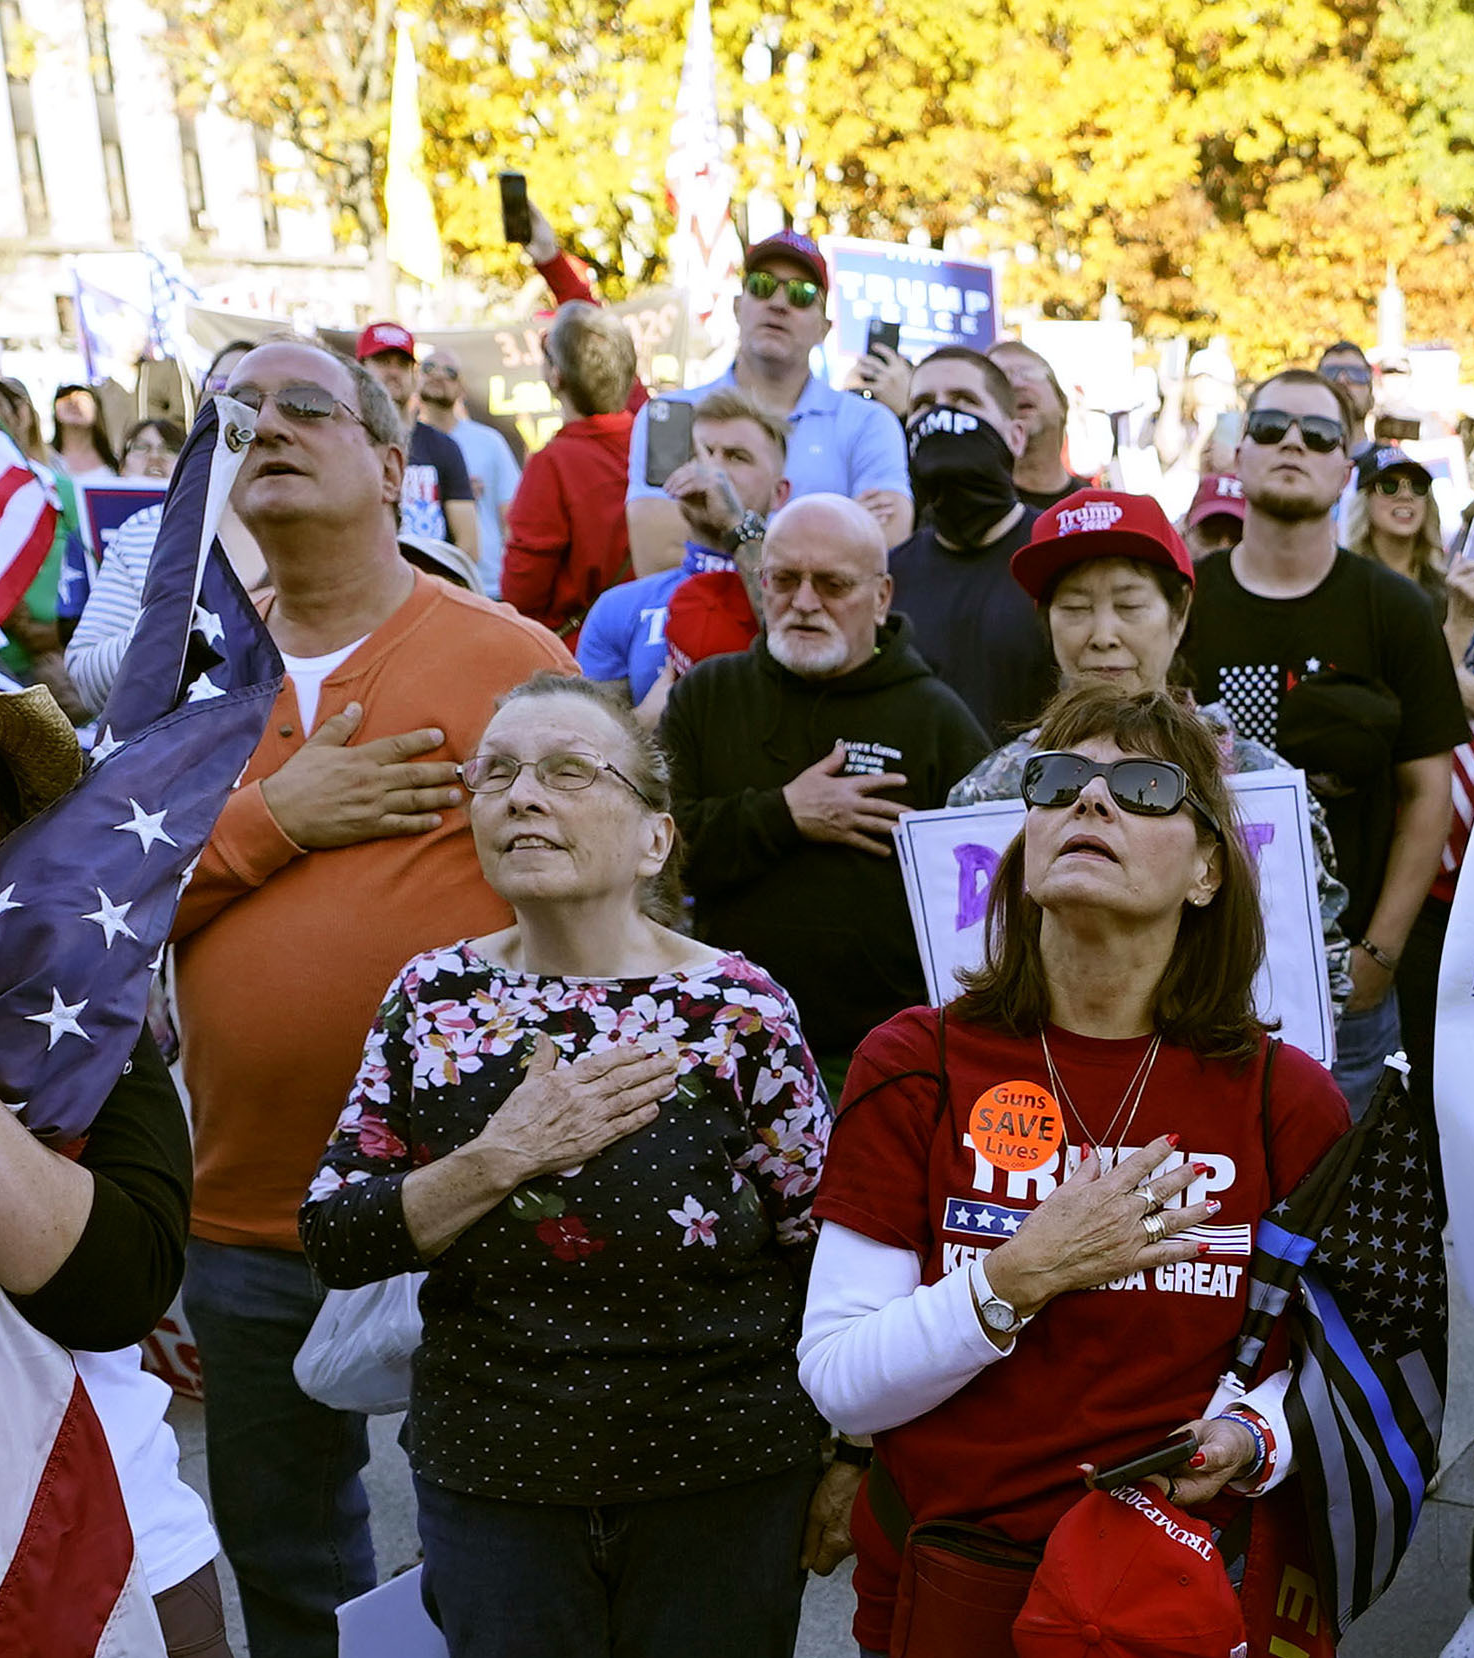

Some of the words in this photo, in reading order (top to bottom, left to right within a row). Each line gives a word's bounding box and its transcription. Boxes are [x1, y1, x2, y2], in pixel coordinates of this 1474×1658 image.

[835, 270, 990, 315] TRUMP
[1056, 506, 1123, 529] Trump
[994, 1087, 1046, 1110] Guns
[976, 1108, 1055, 1142] SAVE
[986, 1136, 1039, 1160] Lives
[1154, 1261, 1243, 1298] GREAT
